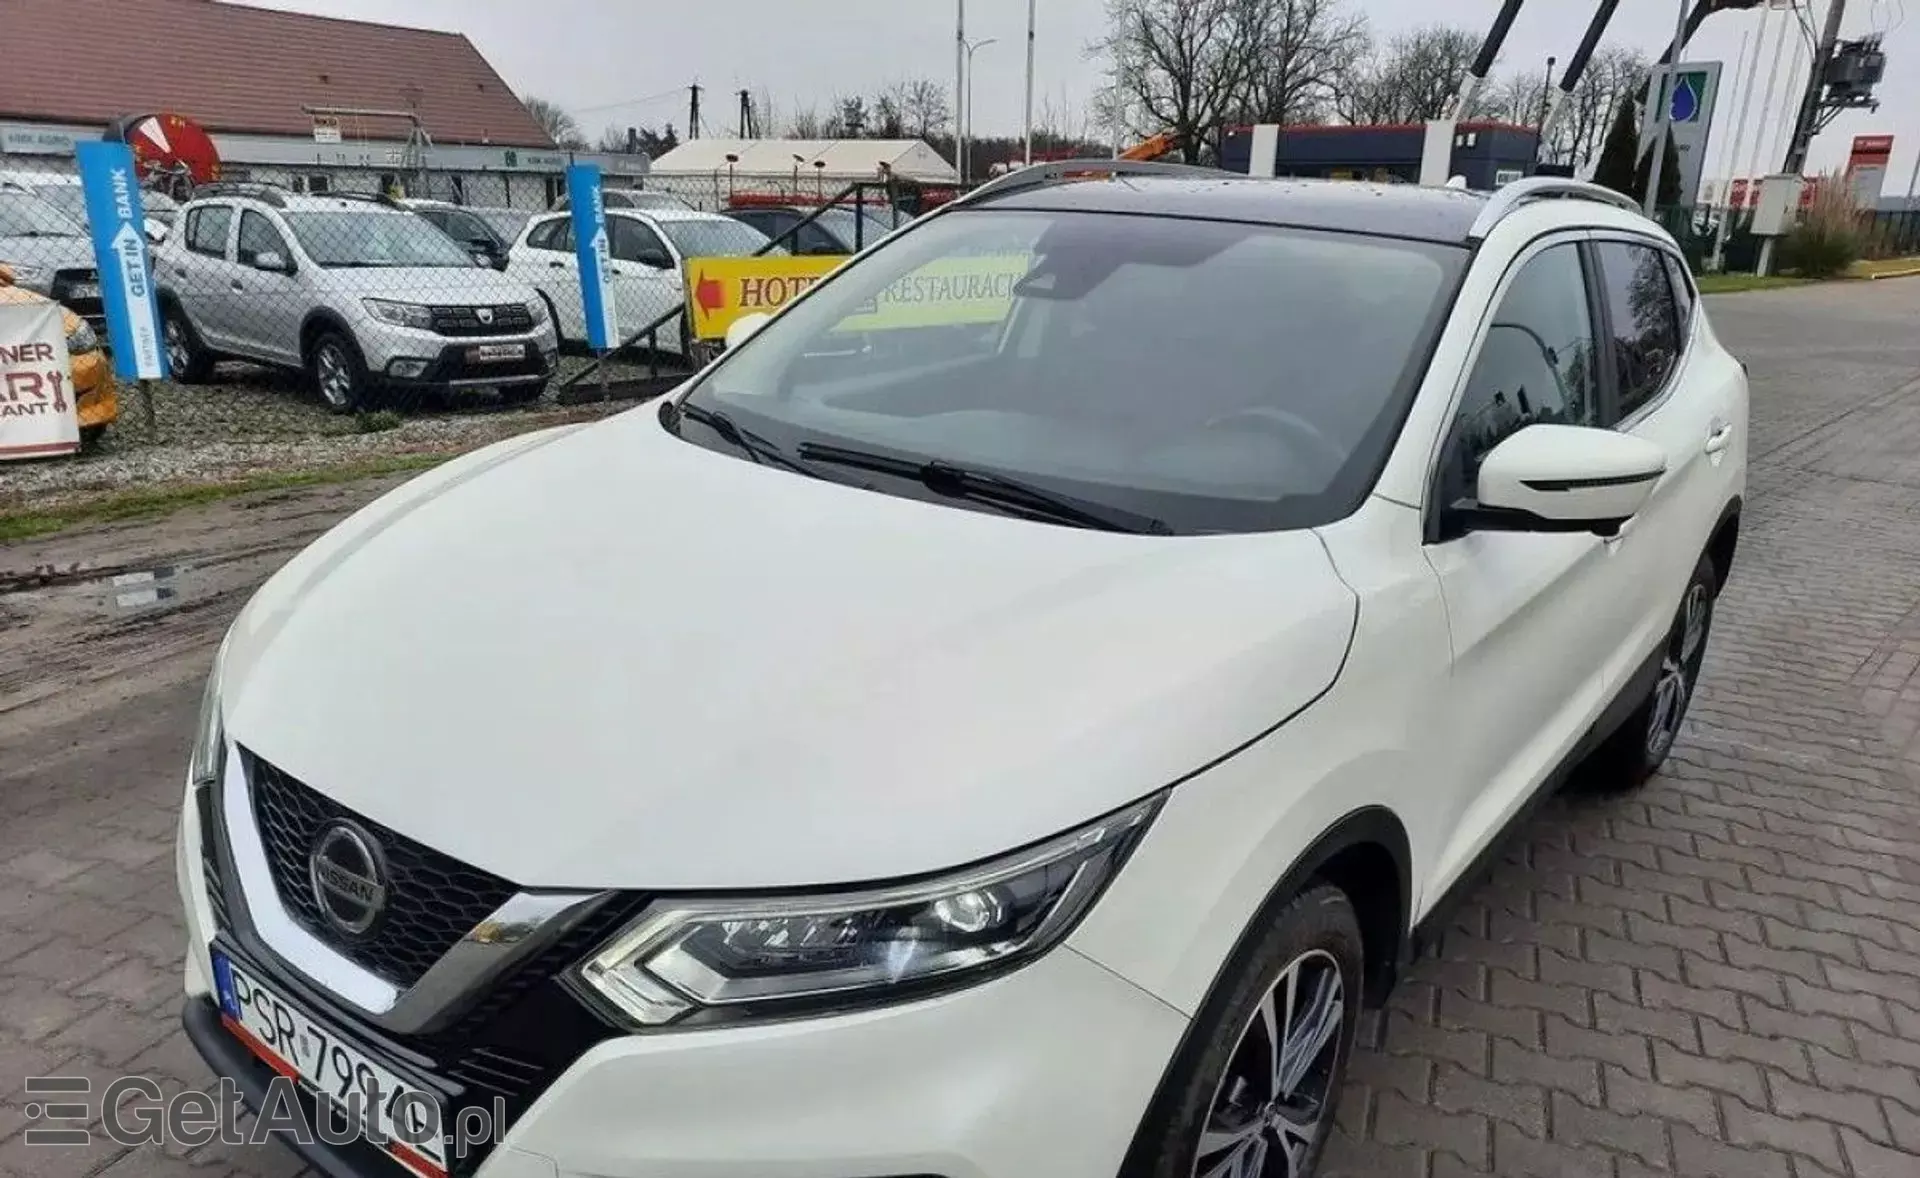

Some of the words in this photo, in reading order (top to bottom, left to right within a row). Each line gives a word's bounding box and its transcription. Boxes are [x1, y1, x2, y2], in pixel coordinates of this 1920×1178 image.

[110, 167, 133, 219] BANK
[591, 184, 605, 223] BANK
[124, 238, 142, 258] IN
[128, 261, 146, 298] GET
[740, 276, 820, 308] HOT
[0, 372, 47, 402] R
[0, 402, 49, 417] ANT
[319, 864, 374, 903] NISSAN
[232, 966, 301, 1068] PSR
